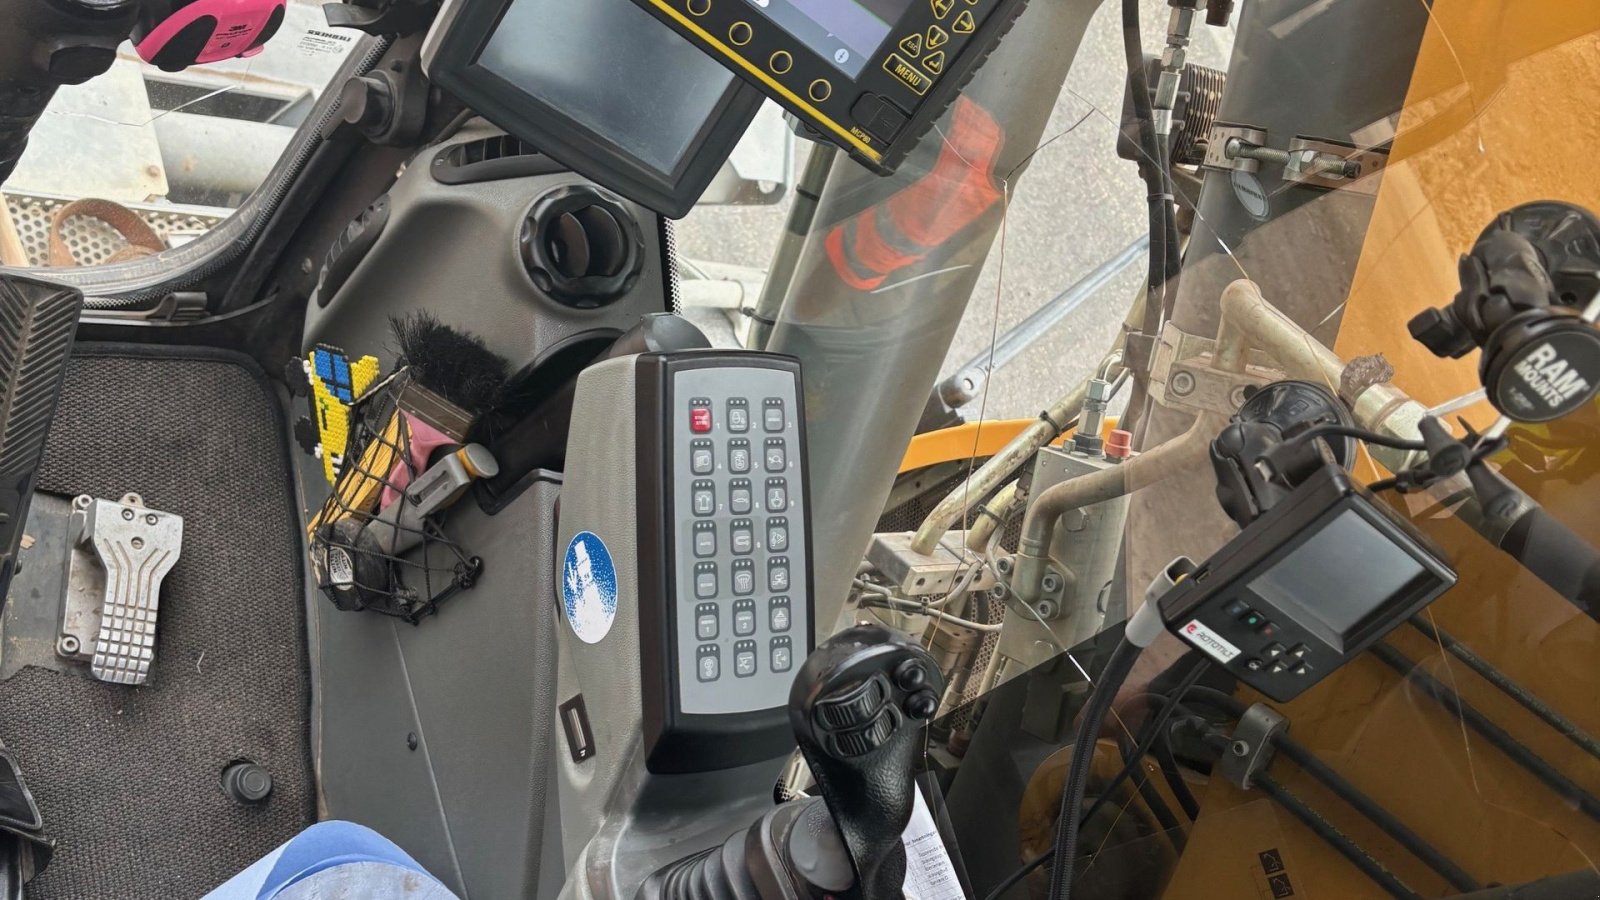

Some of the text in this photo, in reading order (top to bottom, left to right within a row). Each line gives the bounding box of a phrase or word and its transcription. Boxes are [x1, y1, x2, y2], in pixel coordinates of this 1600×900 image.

[228, 24, 247, 32] 3M
[906, 40, 918, 51] ESC
[894, 63, 922, 87] MENU
[1527, 342, 1588, 400] RAM
[1513, 360, 1564, 408] MOUNTS
[1248, 662, 1260, 671] OK
